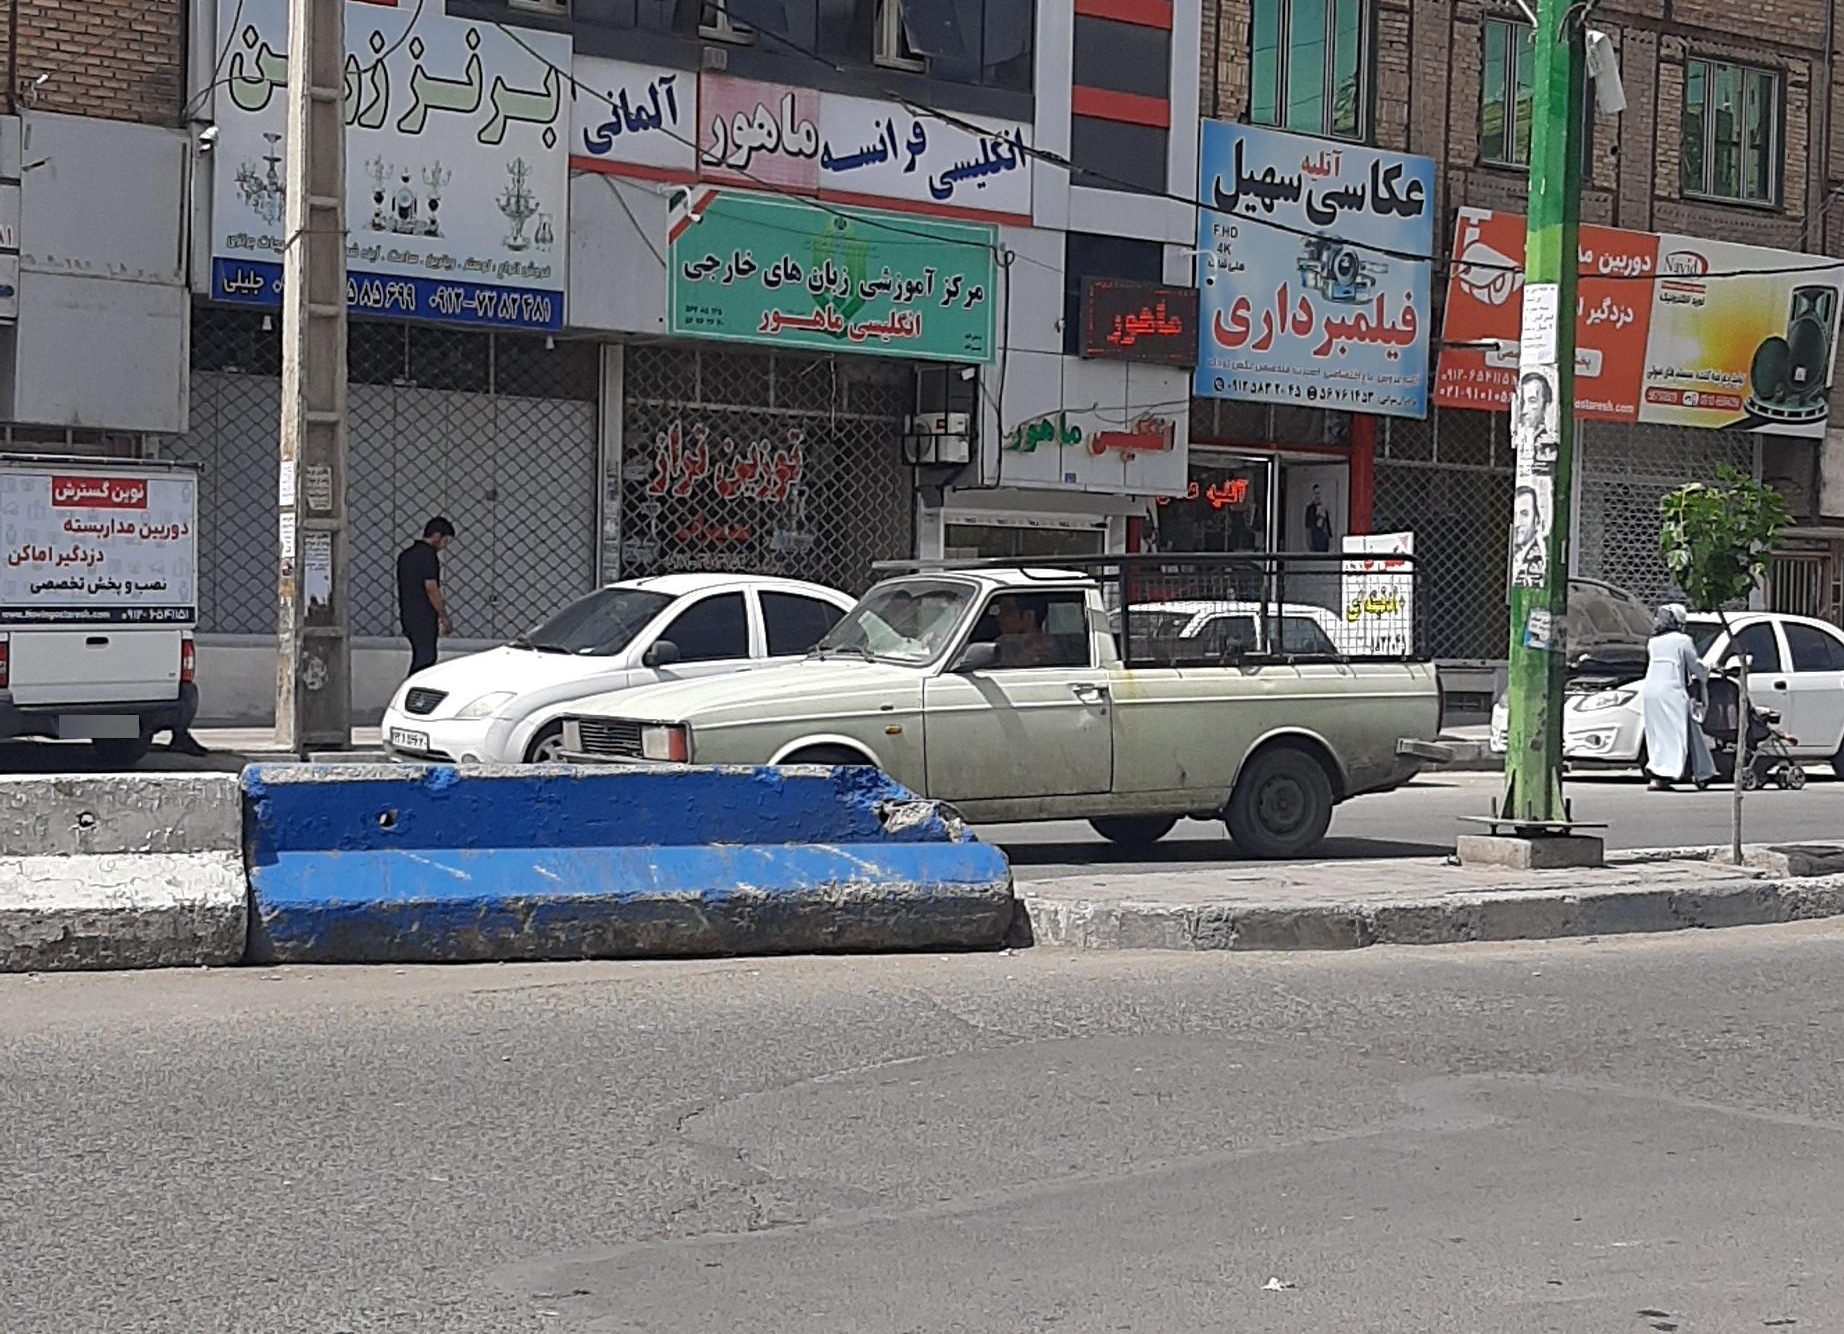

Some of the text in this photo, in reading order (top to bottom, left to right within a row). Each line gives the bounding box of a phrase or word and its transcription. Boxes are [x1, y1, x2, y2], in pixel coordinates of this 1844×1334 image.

[229, 24, 560, 149] برنز زرن
[582, 74, 678, 155] آلمانی
[700, 92, 819, 168] ماهور
[820, 116, 1027, 201] انگلیسی فرانسه
[1213, 138, 1427, 226] عکاسی سهیل
[1216, 242, 1232, 256] 4K
[1599, 252, 1651, 276] دوربین
[223, 267, 266, 295] جلیلی
[683, 250, 985, 310] مرکز آموزشی زبان های خارجی
[756, 302, 922, 342] انگلیسی ماهور
[1106, 299, 1184, 347] ماهور
[1213, 281, 1420, 361] فیلمبرداری
[1586, 297, 1634, 329] دزدگیر
[1004, 410, 1083, 454] ماهور
[54, 480, 144, 503] نوین گسترش
[63, 517, 190, 540] دوربین مداربسته
[8, 543, 105, 567] دزدگیر اماکن
[30, 575, 168, 597] نصب و پخش تخصصی
